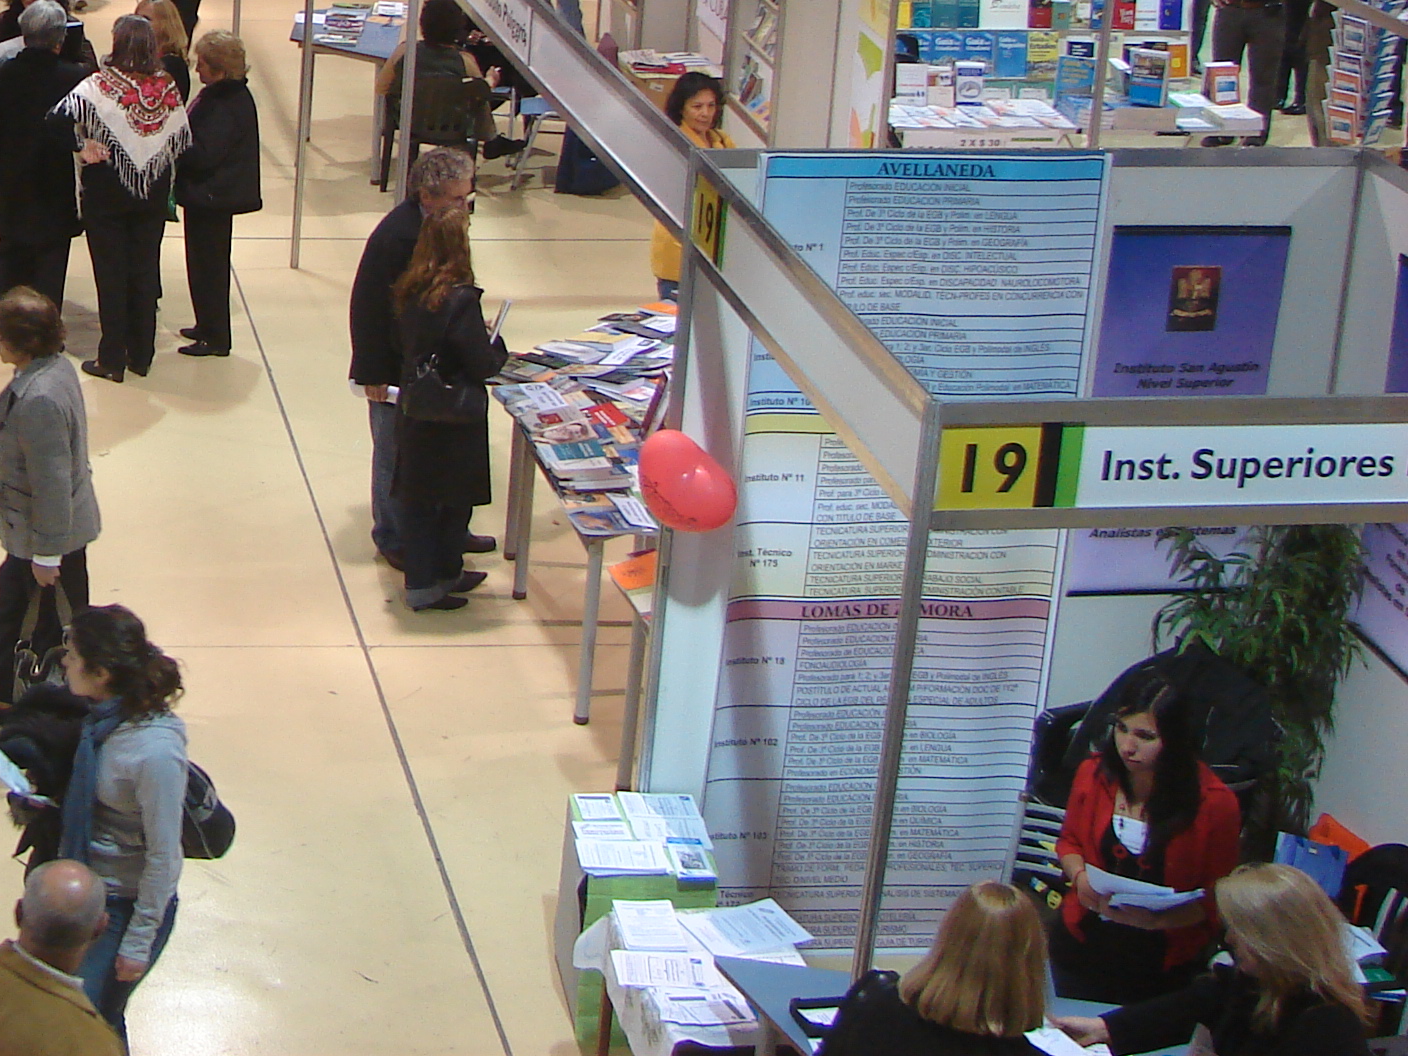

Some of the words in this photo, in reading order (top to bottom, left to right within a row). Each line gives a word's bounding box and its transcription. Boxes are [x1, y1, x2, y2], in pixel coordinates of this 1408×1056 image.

[877, 162, 996, 178] AVELLANEDA
[697, 192, 715, 244] 19
[1113, 362, 1176, 374] Instituto
[1179, 362, 1205, 374] San
[1208, 361, 1261, 375] Agustín
[1136, 377, 1173, 389] Nivel
[1176, 376, 1235, 390] Superior
[750, 398, 784, 406] Instituto
[961, 442, 1028, 494] 19
[1100, 450, 1180, 481] Inst.
[1190, 447, 1395, 489] Superiores
[1088, 526, 1152, 538] Analistas
[757, 547, 792, 557] Técnico
[801, 604, 861, 618] LOMAS
[867, 603, 889, 616] DE
